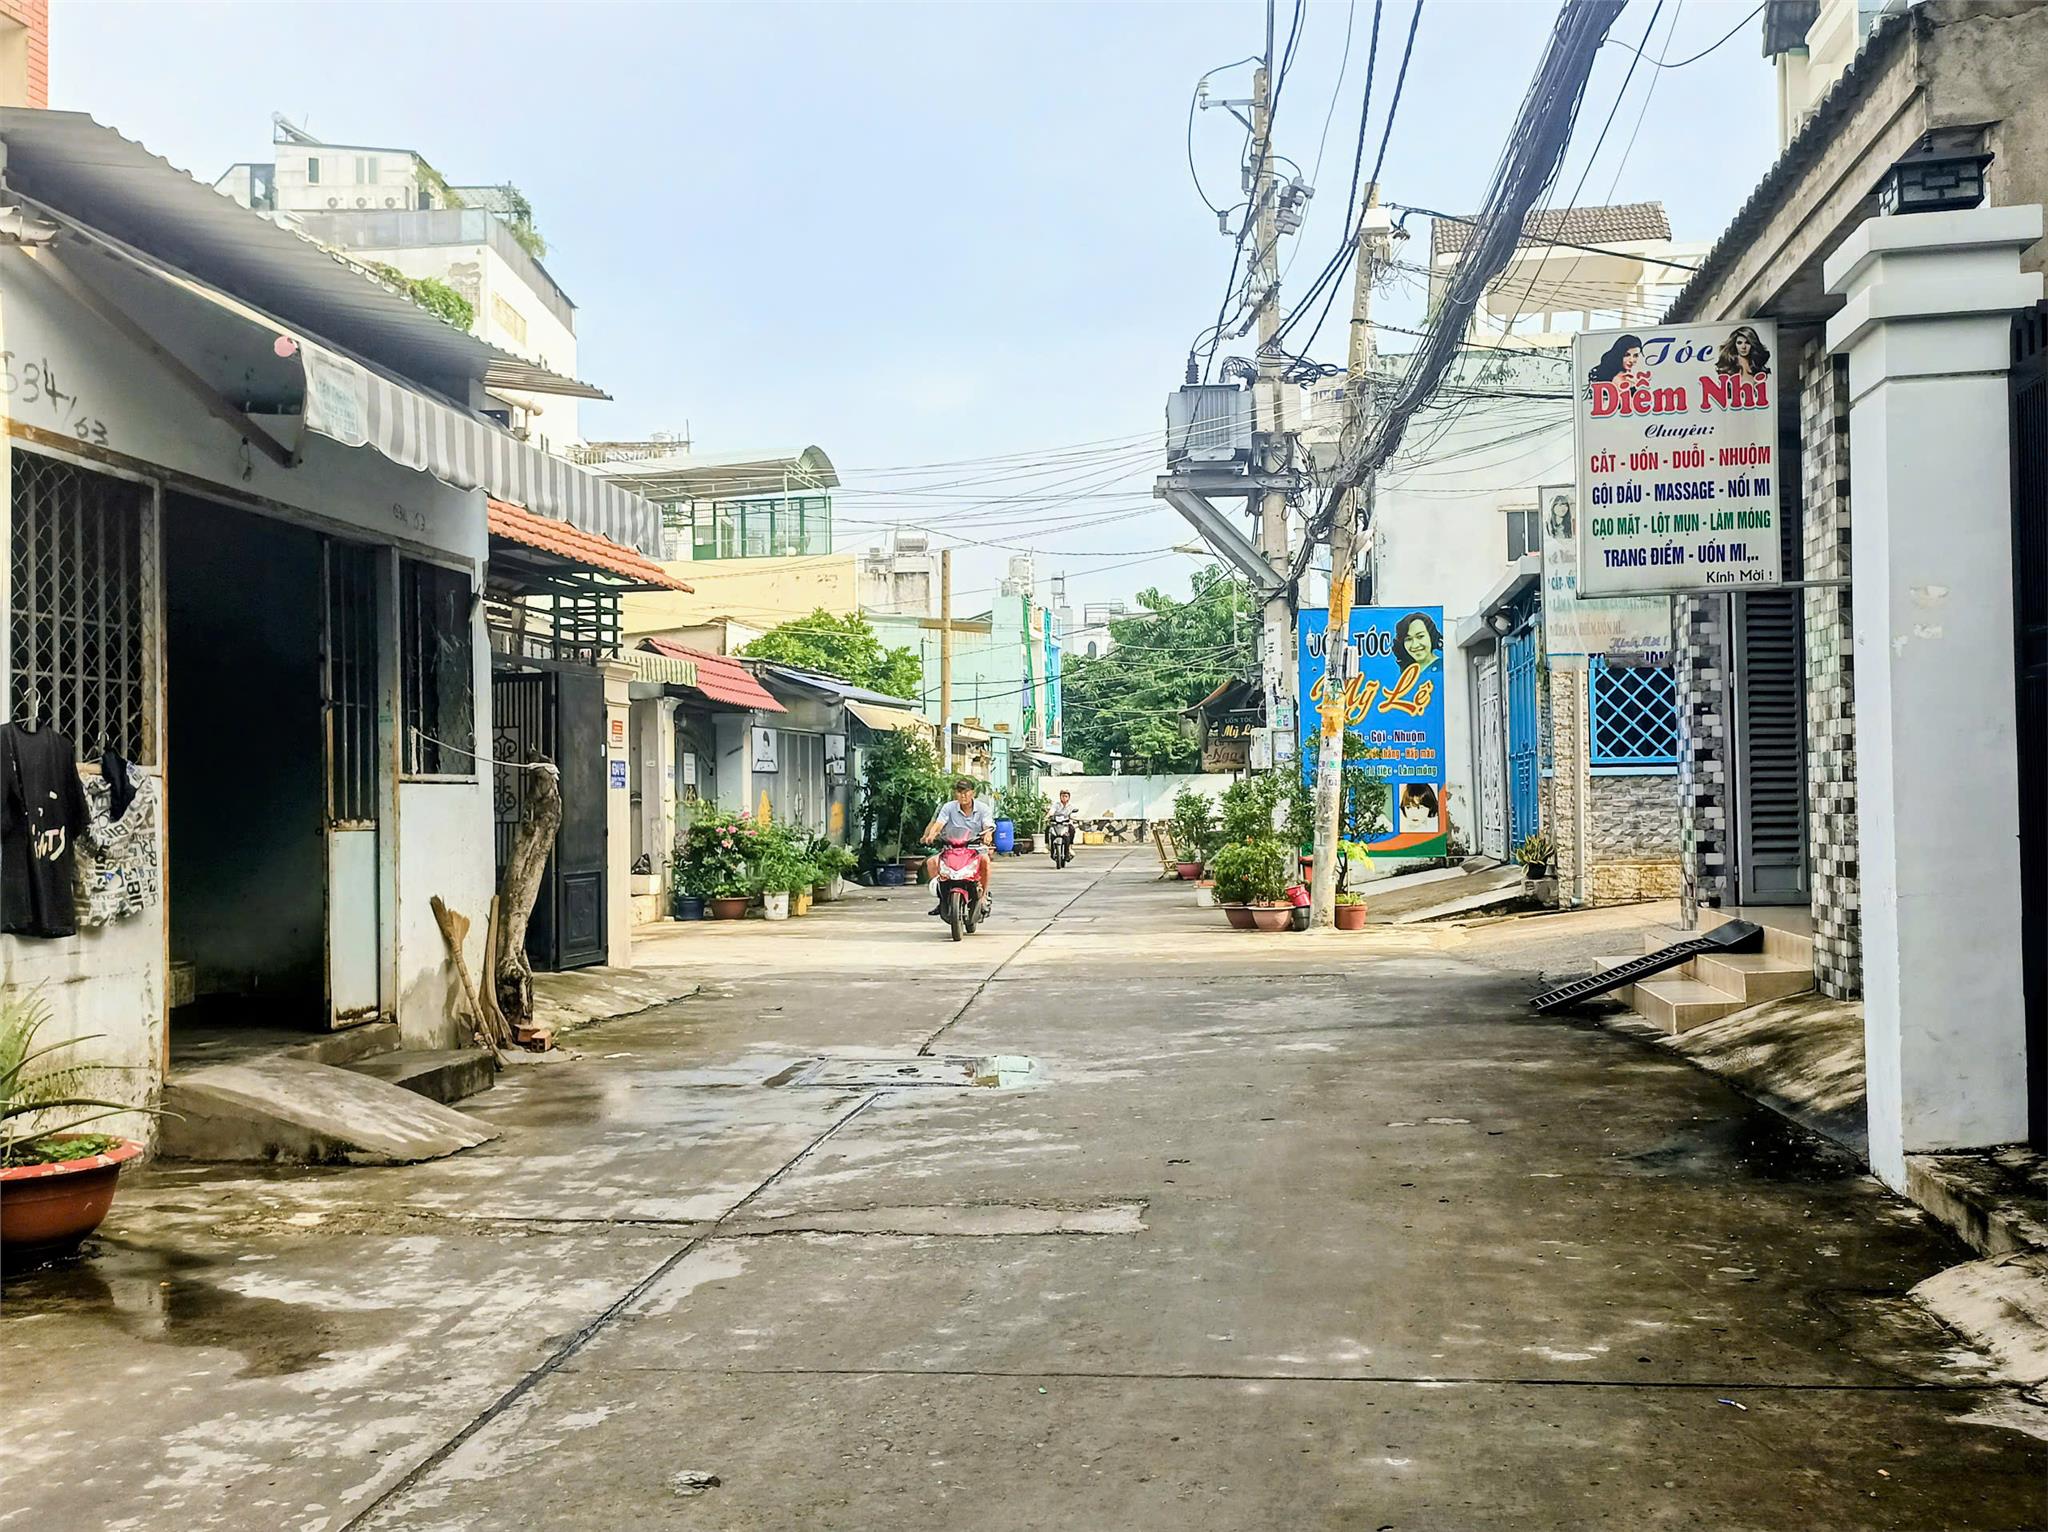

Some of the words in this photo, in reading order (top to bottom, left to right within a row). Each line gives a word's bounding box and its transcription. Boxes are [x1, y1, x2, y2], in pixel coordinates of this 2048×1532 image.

[1642, 337, 1714, 366] Tóc
[1590, 371, 1688, 419] Diễm
[1699, 372, 1769, 412] Nhi
[1644, 424, 1715, 439] Chuyên:
[1590, 448, 1616, 473] CẮT
[1630, 446, 1659, 471] UỐN
[1672, 443, 1705, 469] DUỖI
[1719, 443, 1771, 469] NHUỘM
[1592, 482, 1613, 509] GỘI
[1616, 478, 1642, 504] ĐẦU
[1654, 481, 1715, 502] MASSAGE
[1728, 472, 1750, 498] NỐI
[1754, 478, 1771, 496] MI
[1592, 518, 1614, 540] CẠO
[1617, 513, 1641, 539] MẶT
[1651, 511, 1670, 537] LỘT
[1674, 513, 1699, 536] MỤN
[1710, 509, 1734, 531] LÀM
[1737, 507, 1771, 530] MÓNG
[1604, 548, 1647, 568] TRANG
[1650, 539, 1684, 566] ĐIỂM
[1698, 538, 1726, 563] UỐN
[1706, 570, 1735, 584] Kính
[1740, 569, 1765, 582] Mời
[1354, 625, 1391, 658] TÓC
[1378, 663, 1433, 717] Lệ
